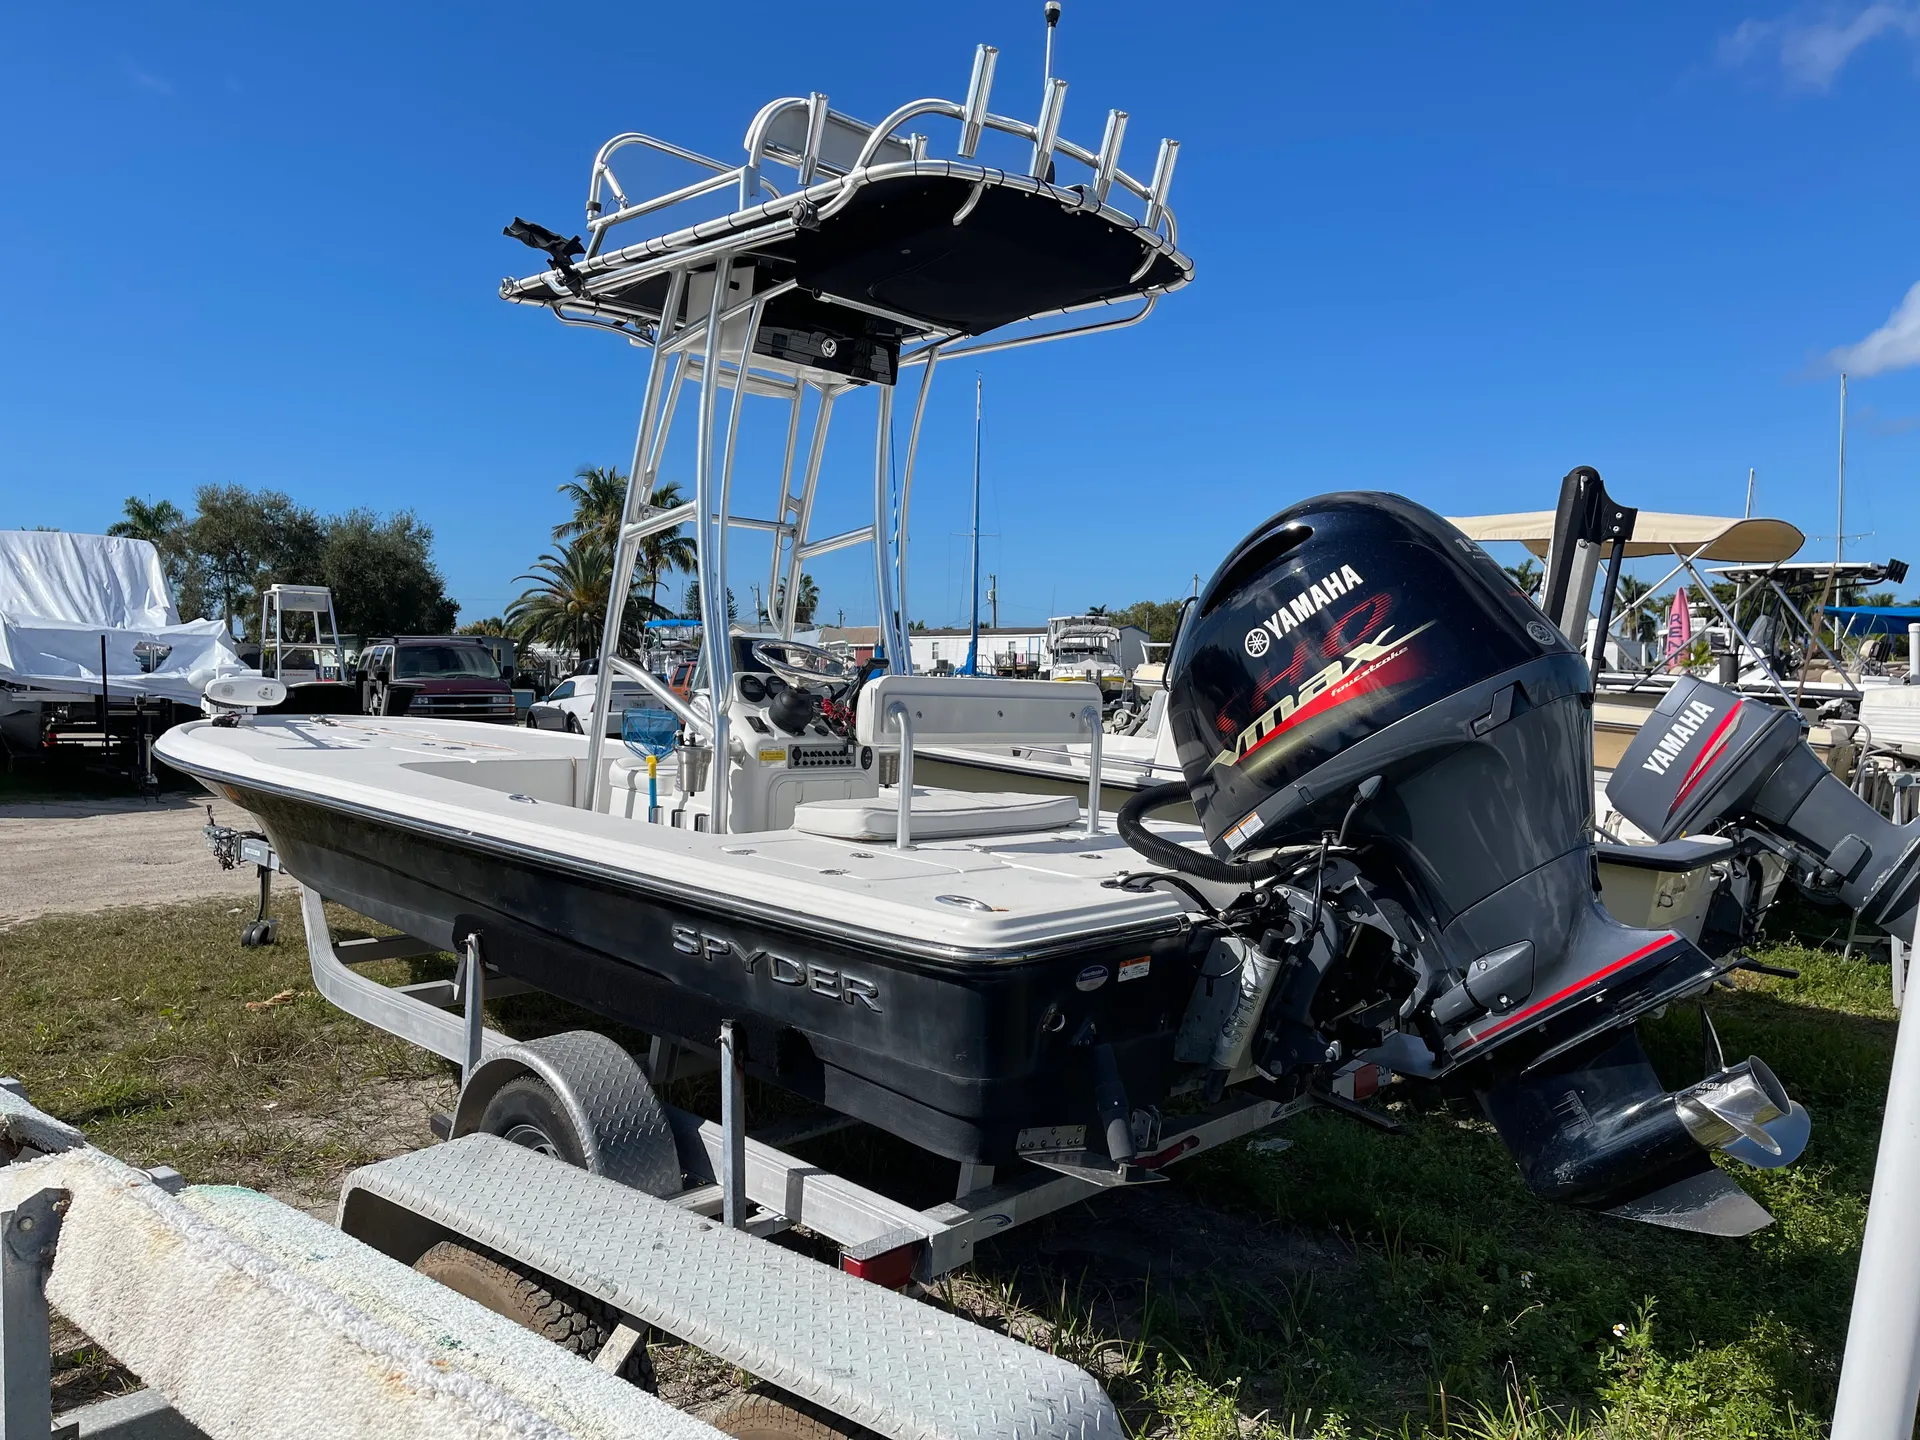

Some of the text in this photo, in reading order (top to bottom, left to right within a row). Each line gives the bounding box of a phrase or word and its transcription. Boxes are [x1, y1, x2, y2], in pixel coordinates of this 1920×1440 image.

[1263, 564, 1364, 640] YAMAHA
[1667, 613, 1685, 664] RENT
[1642, 700, 1715, 776] YAMAHA
[672, 923, 882, 1013] SPYDER
[1221, 975, 1263, 1043] ATLAS
